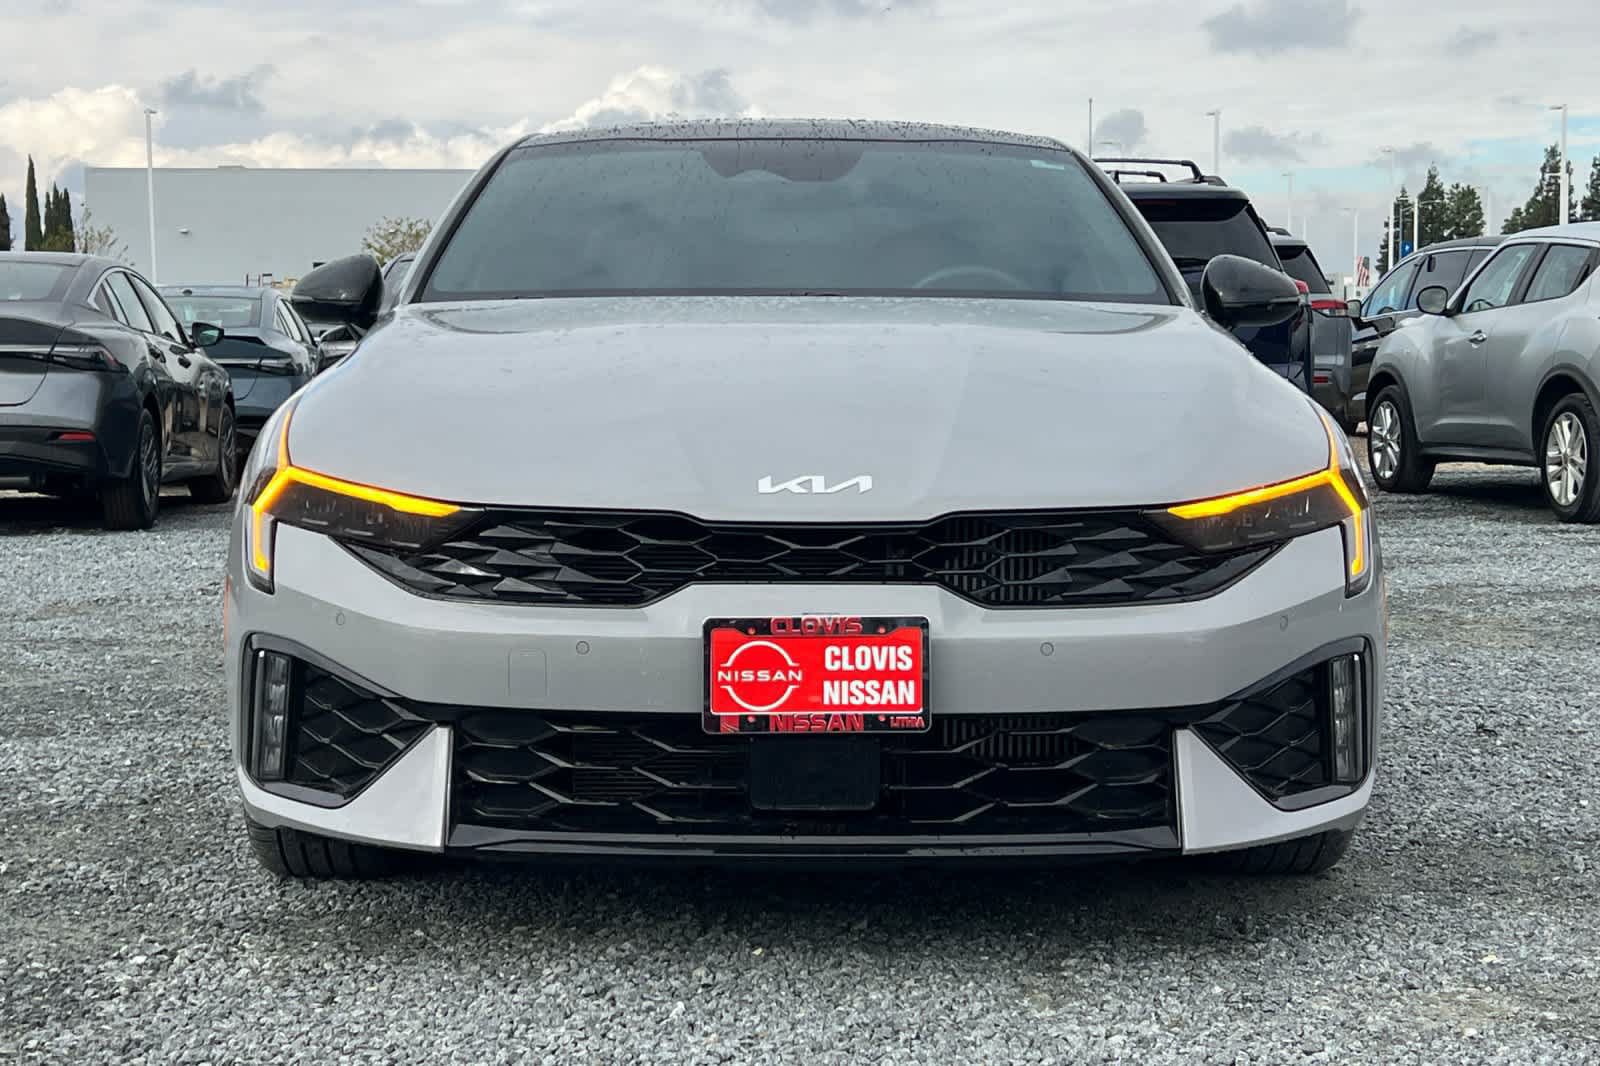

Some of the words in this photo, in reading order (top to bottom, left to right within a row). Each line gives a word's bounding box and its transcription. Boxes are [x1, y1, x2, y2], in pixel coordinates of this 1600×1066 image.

[770, 616, 863, 635] CLOVIS
[824, 645, 913, 671] CLOVIS
[717, 670, 803, 682] NISSAN
[822, 680, 915, 705] NISSAN
[769, 714, 864, 733] NISSAN
